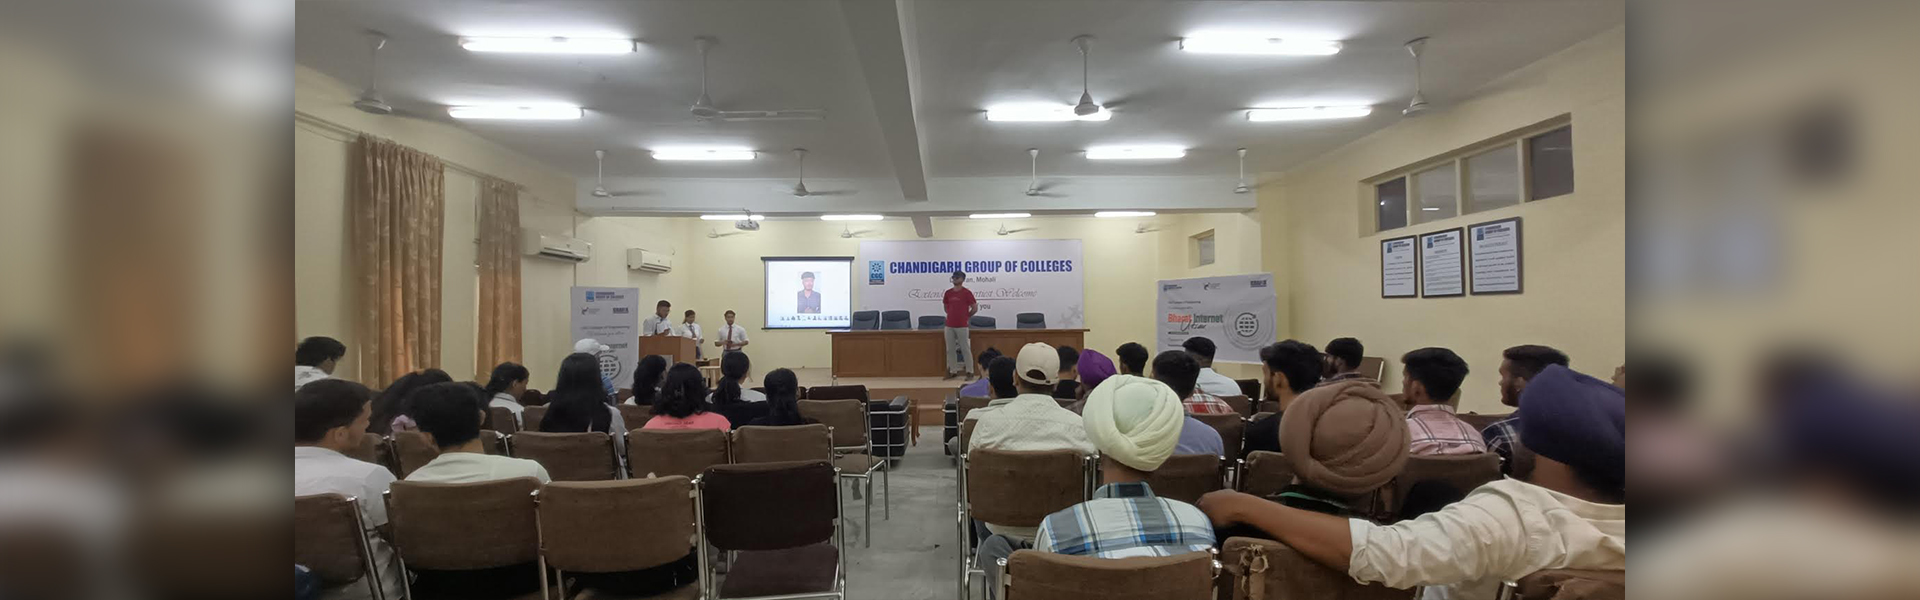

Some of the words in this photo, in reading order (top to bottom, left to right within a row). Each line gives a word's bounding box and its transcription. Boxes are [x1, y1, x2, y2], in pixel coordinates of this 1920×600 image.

[890, 261, 962, 274] CHANDIGARH
[965, 260, 1002, 273] GROUP
[1004, 260, 1018, 273] OF
[1020, 260, 1073, 272] COLLEGES
[1168, 313, 1192, 322] Bharat
[1193, 313, 1224, 324] Internet
